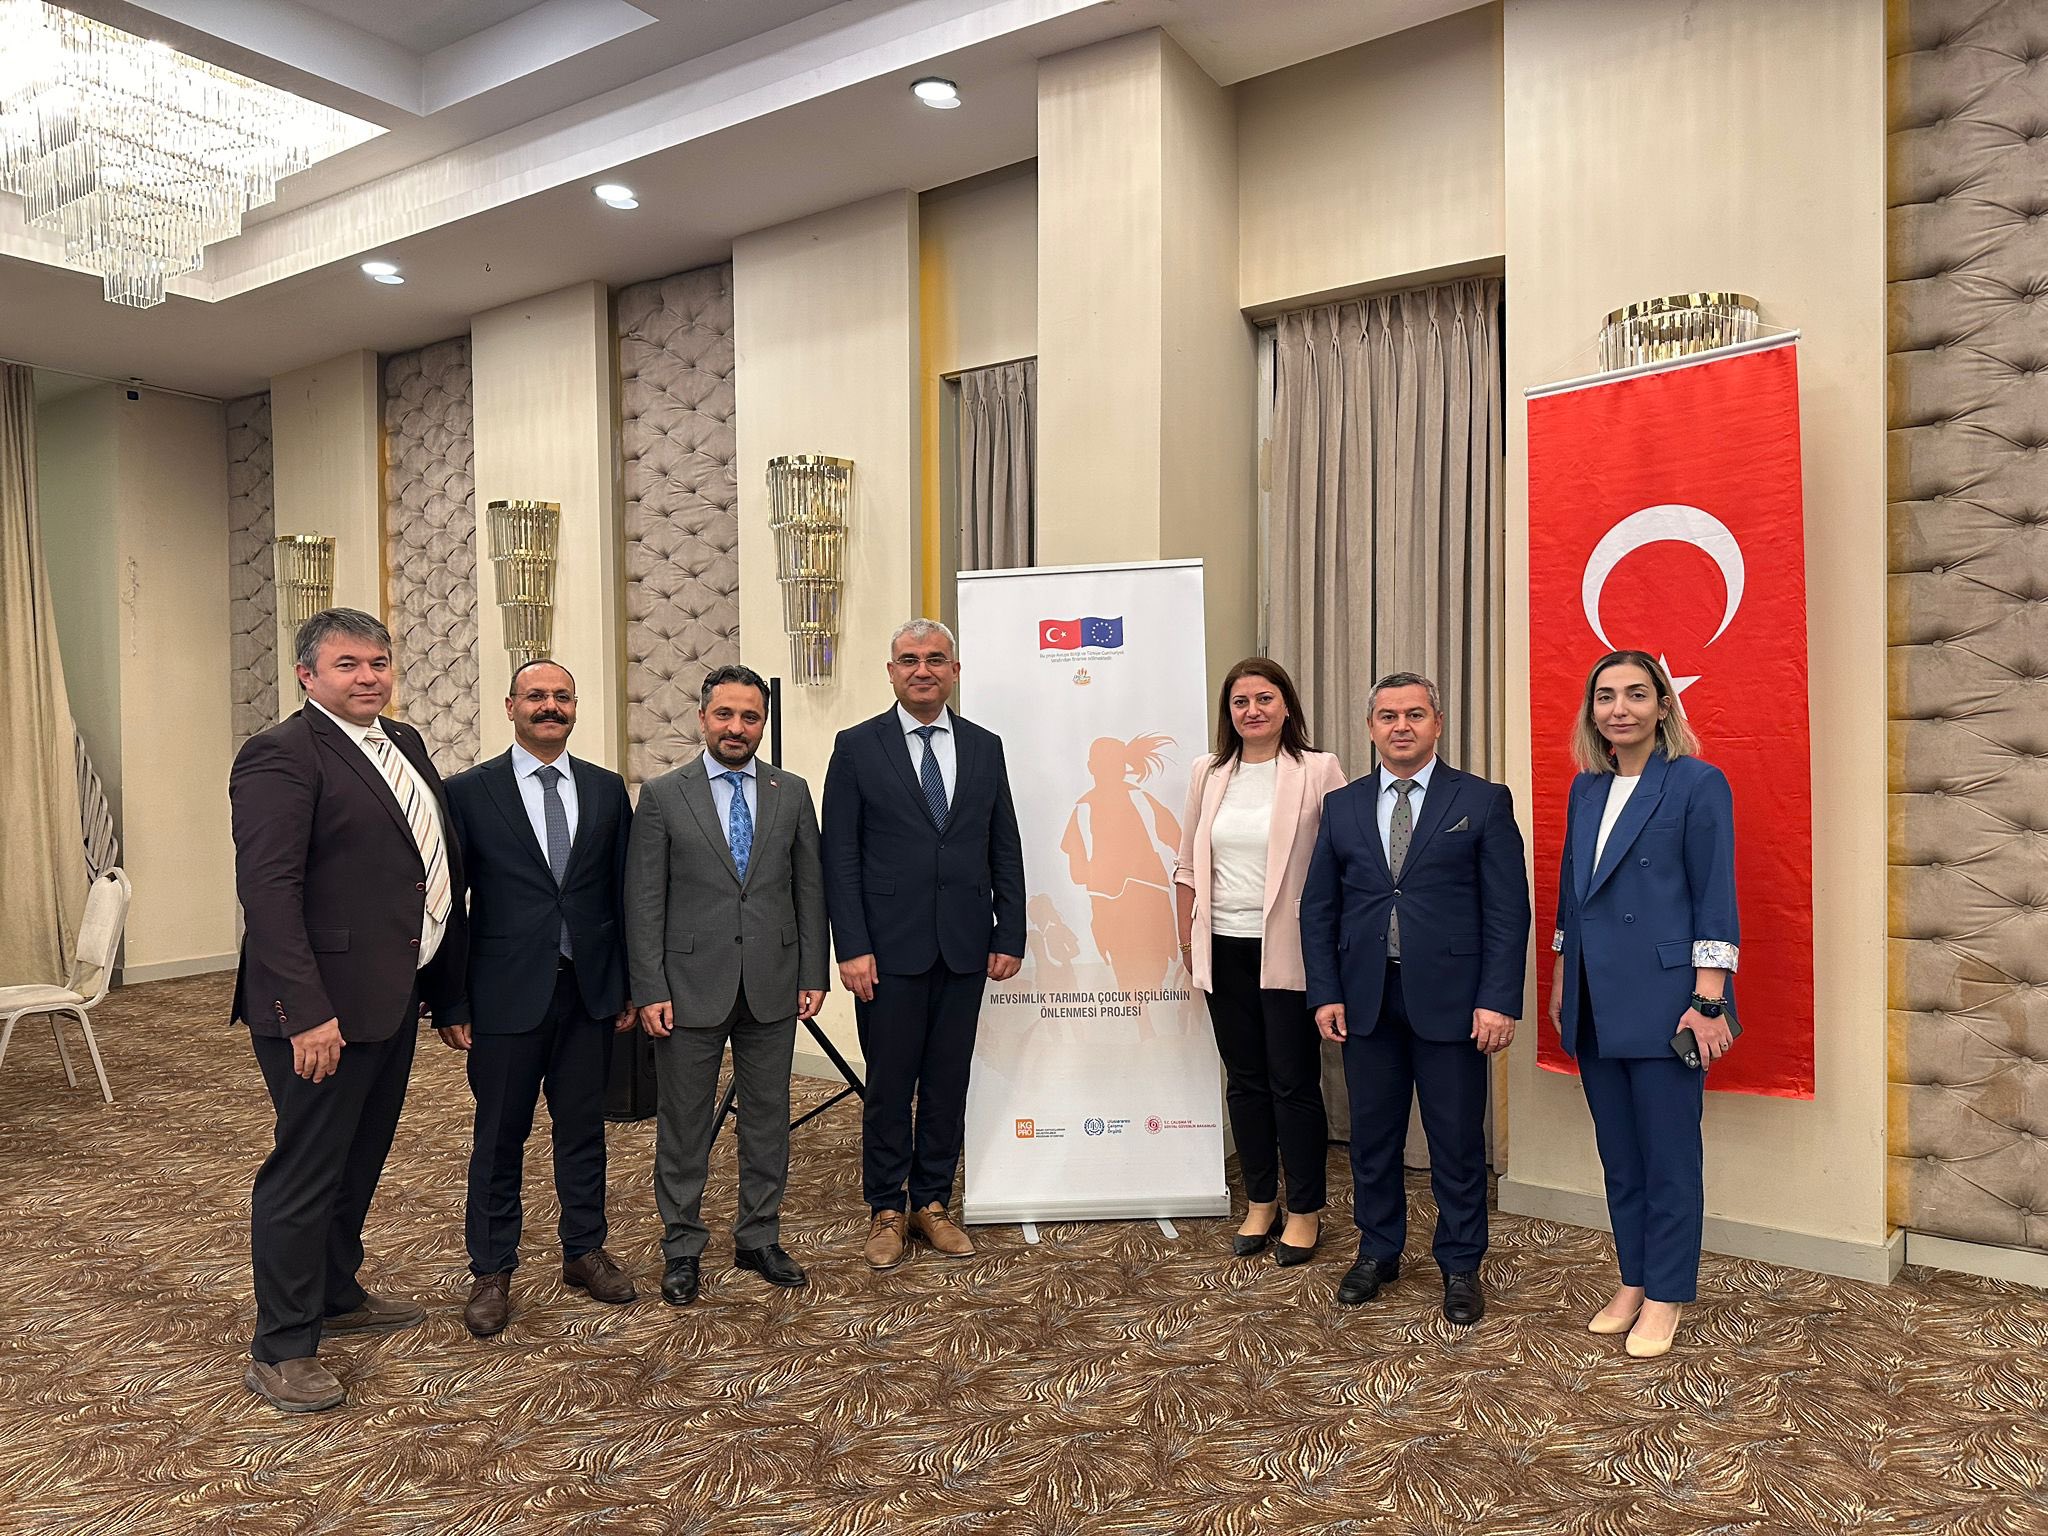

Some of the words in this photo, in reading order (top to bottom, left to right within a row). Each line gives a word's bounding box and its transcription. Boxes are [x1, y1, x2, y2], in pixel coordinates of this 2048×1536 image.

[990, 991, 1047, 1005] MEVSİMLİK
[1049, 992, 1095, 1003] TARIMDA
[1098, 991, 1132, 1005] ÇOCUK
[1134, 988, 1190, 1004] İŞÇİLİĞİNİN
[1040, 1005, 1097, 1018] ÖNLENMESİ
[1100, 1004, 1141, 1017] PROJESİ
